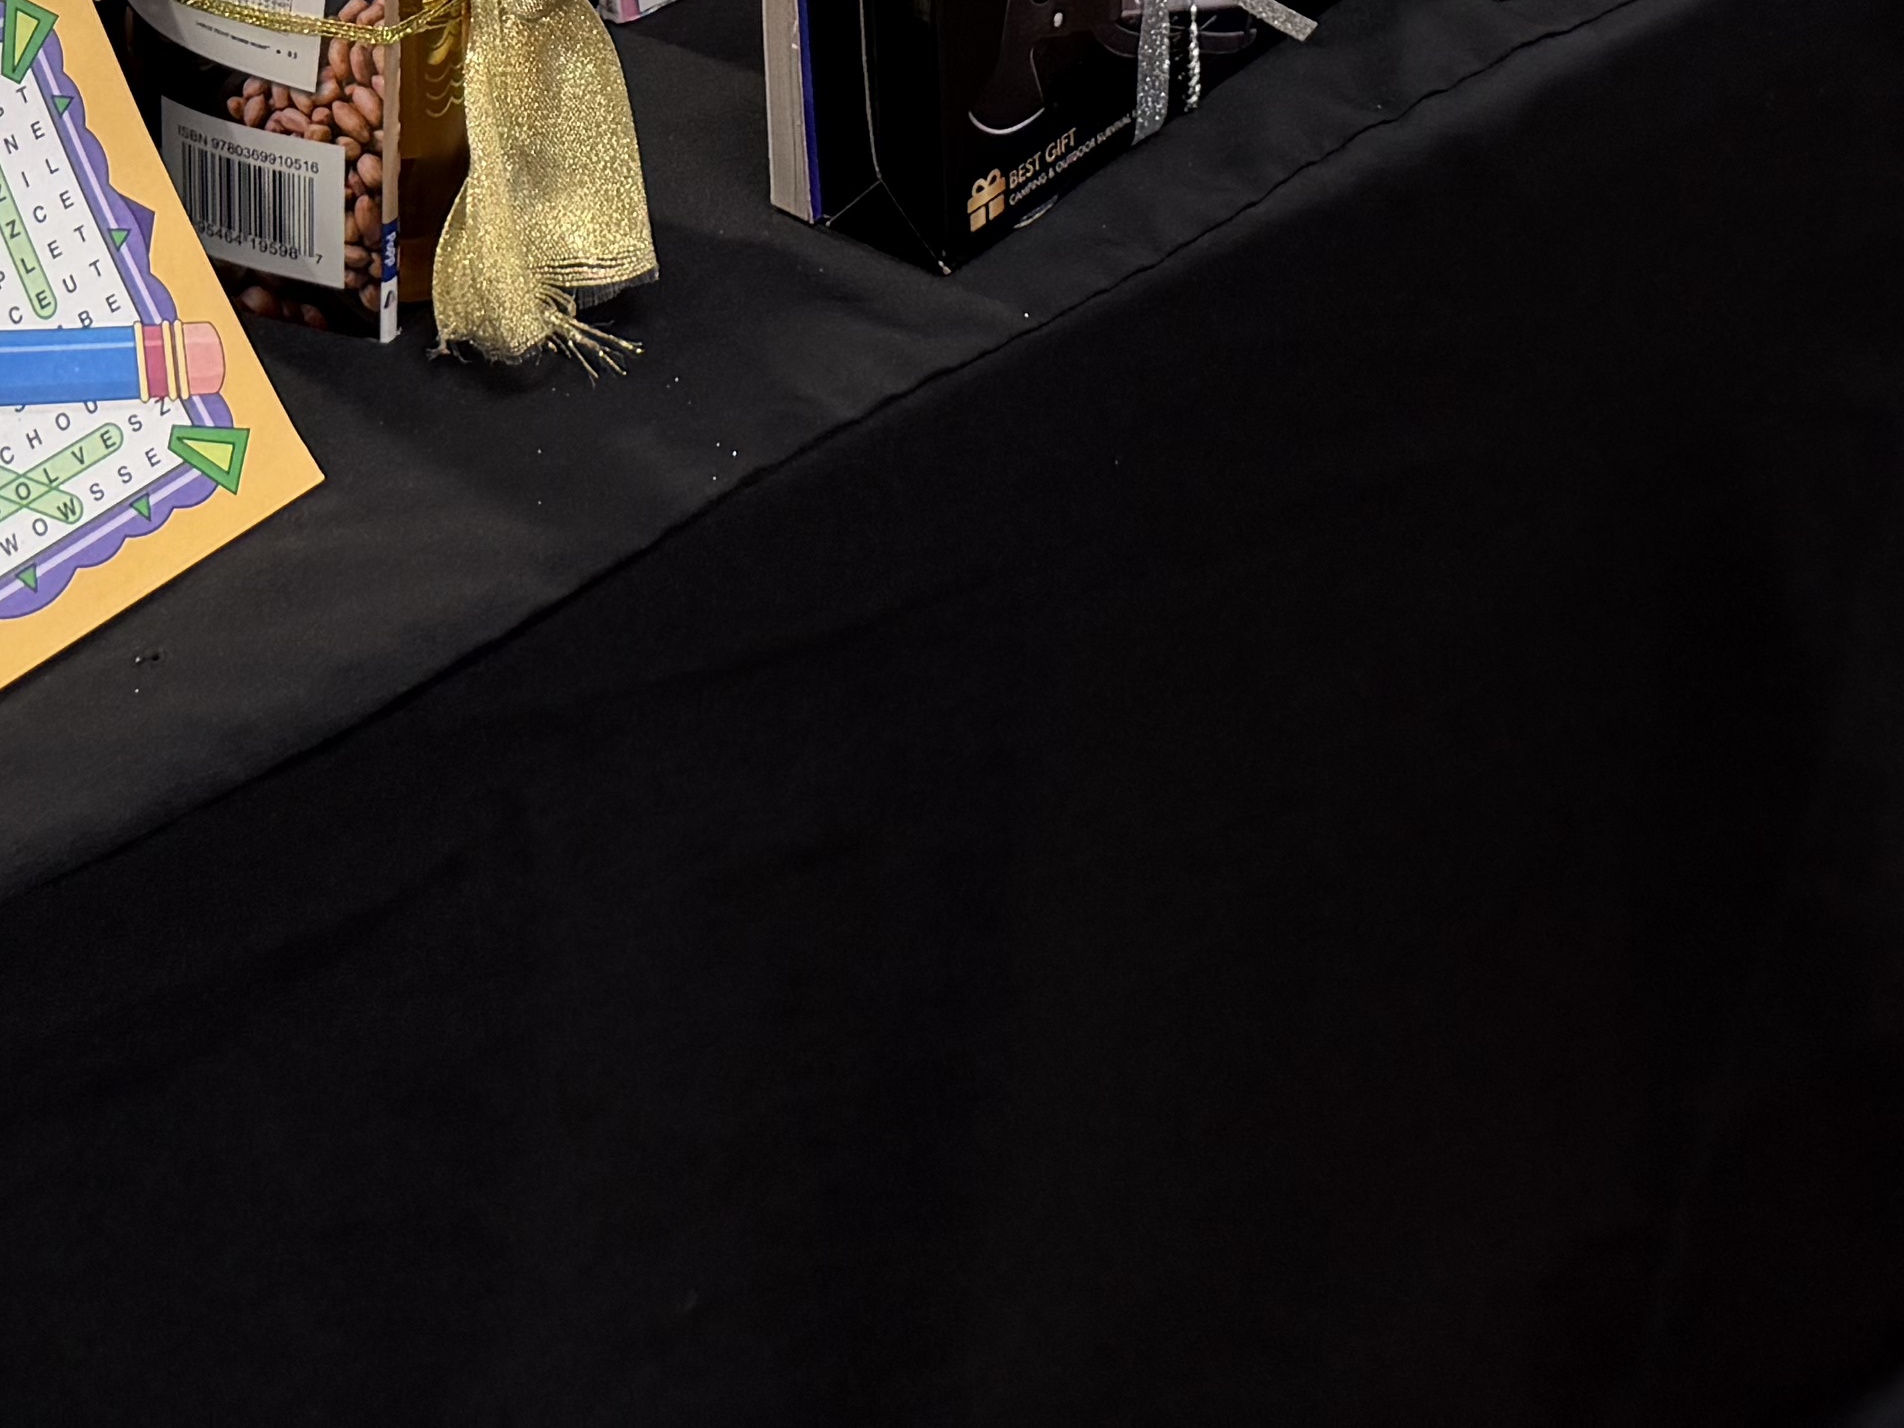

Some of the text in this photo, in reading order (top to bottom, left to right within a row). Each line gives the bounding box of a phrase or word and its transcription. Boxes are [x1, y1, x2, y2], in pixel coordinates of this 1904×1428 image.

[177, 125, 320, 175] ISBN 9780369910516
[1009, 127, 1077, 189] BEST GIFT
[1009, 173, 1047, 206] CAMPING
[250, 236, 299, 262] 19598
